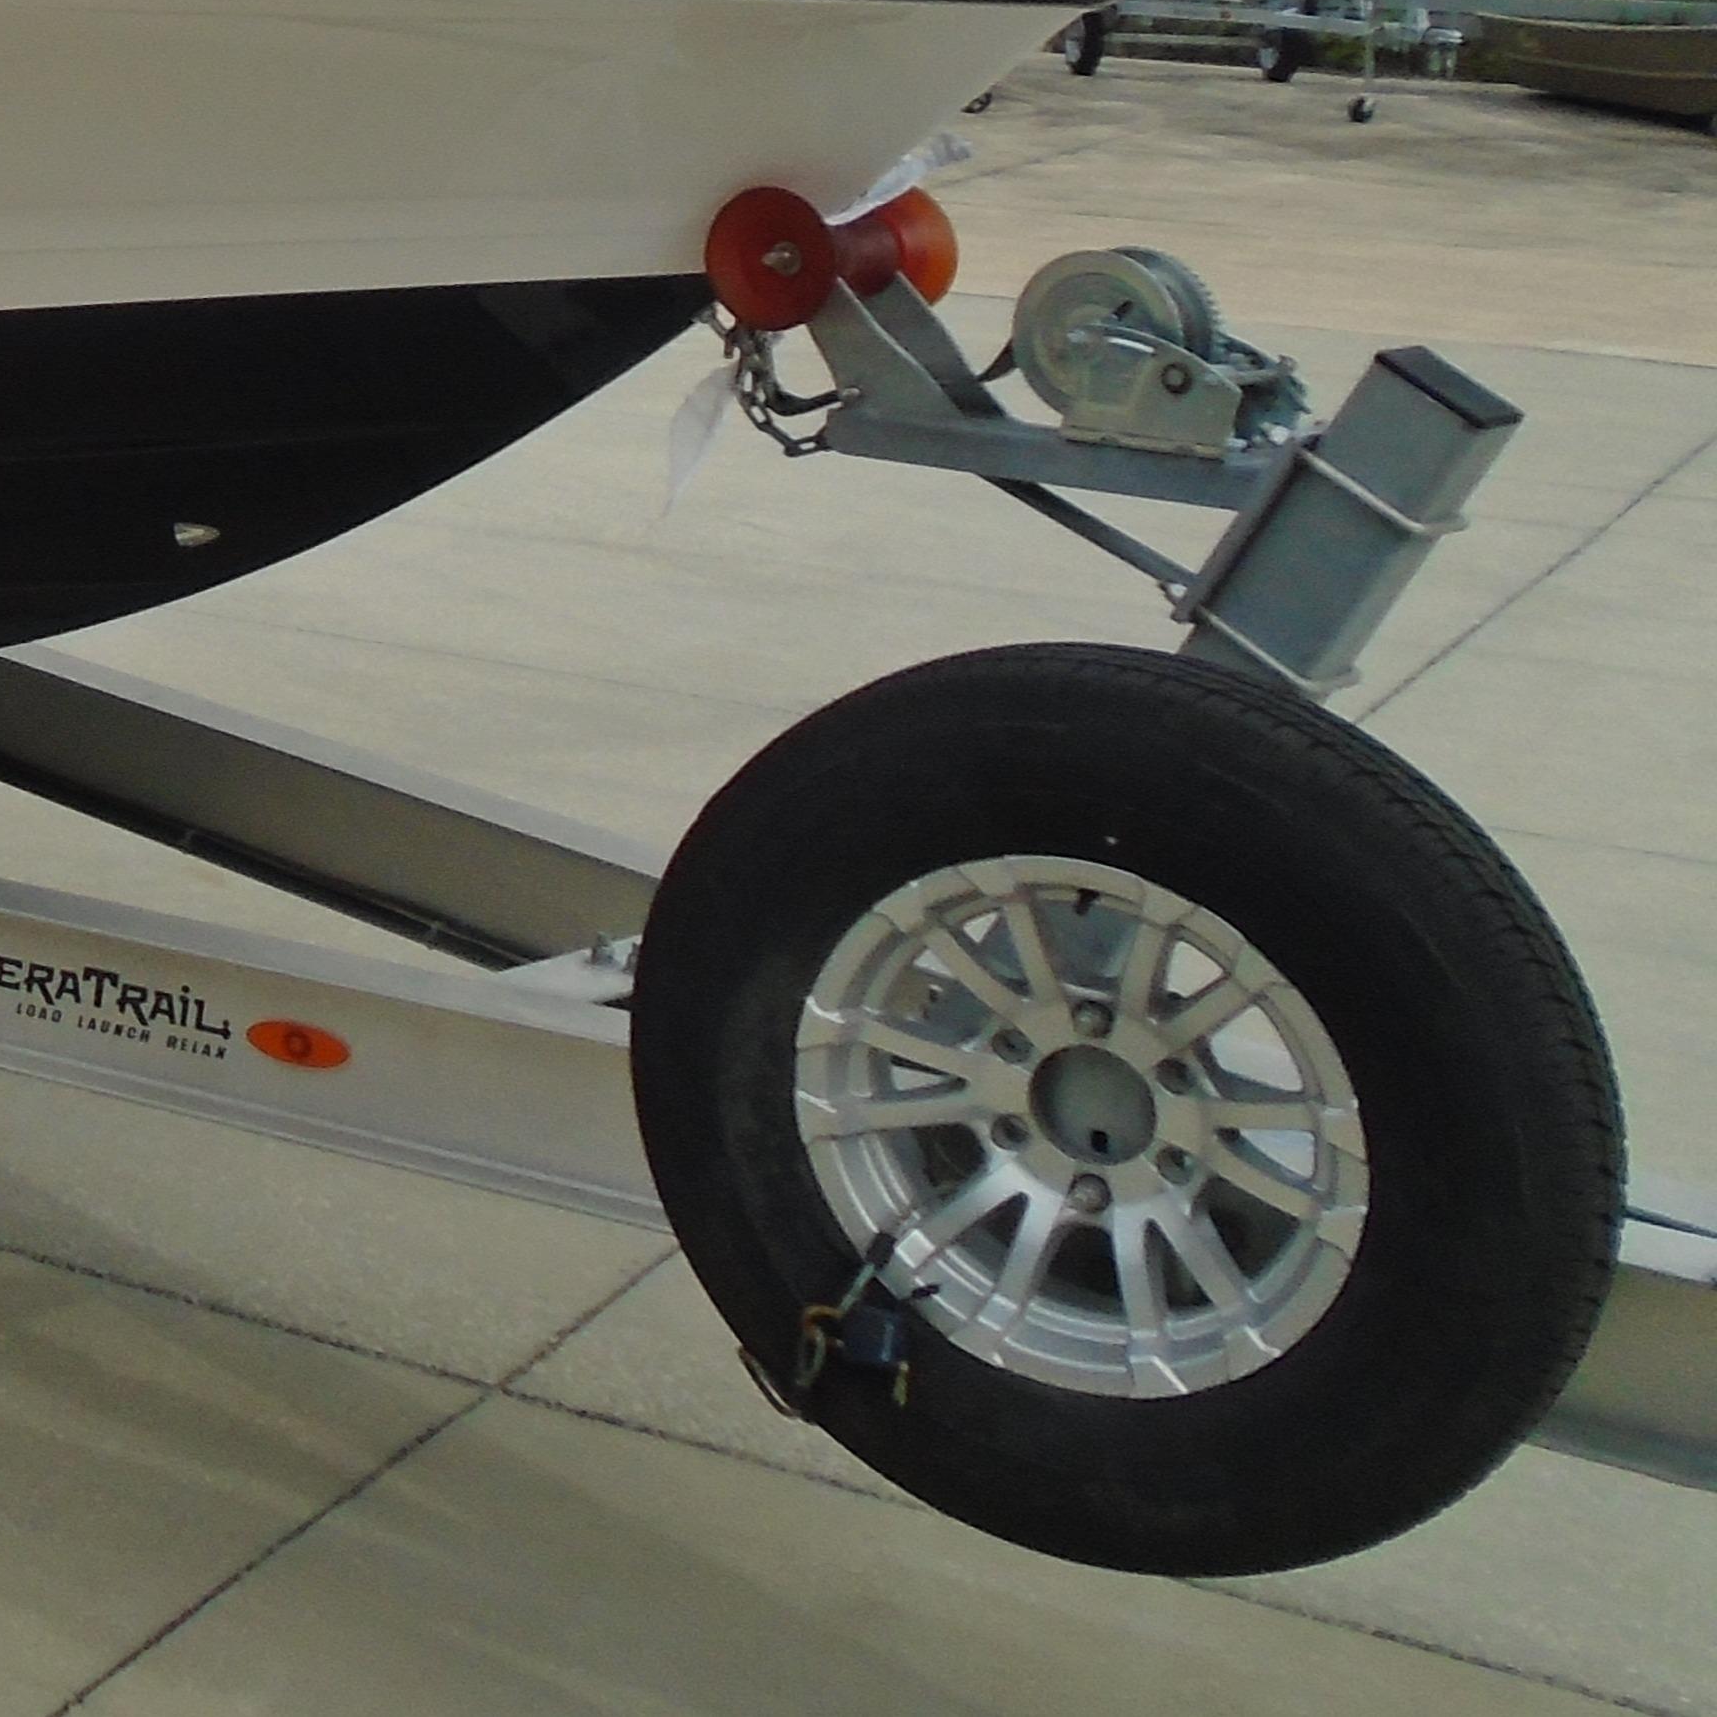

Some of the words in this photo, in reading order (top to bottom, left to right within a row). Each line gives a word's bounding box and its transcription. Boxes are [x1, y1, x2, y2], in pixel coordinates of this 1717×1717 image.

[16, 1002, 63, 1023] LOAD
[77, 1014, 151, 1043] LAUNCH
[166, 1035, 228, 1060] RELAX
